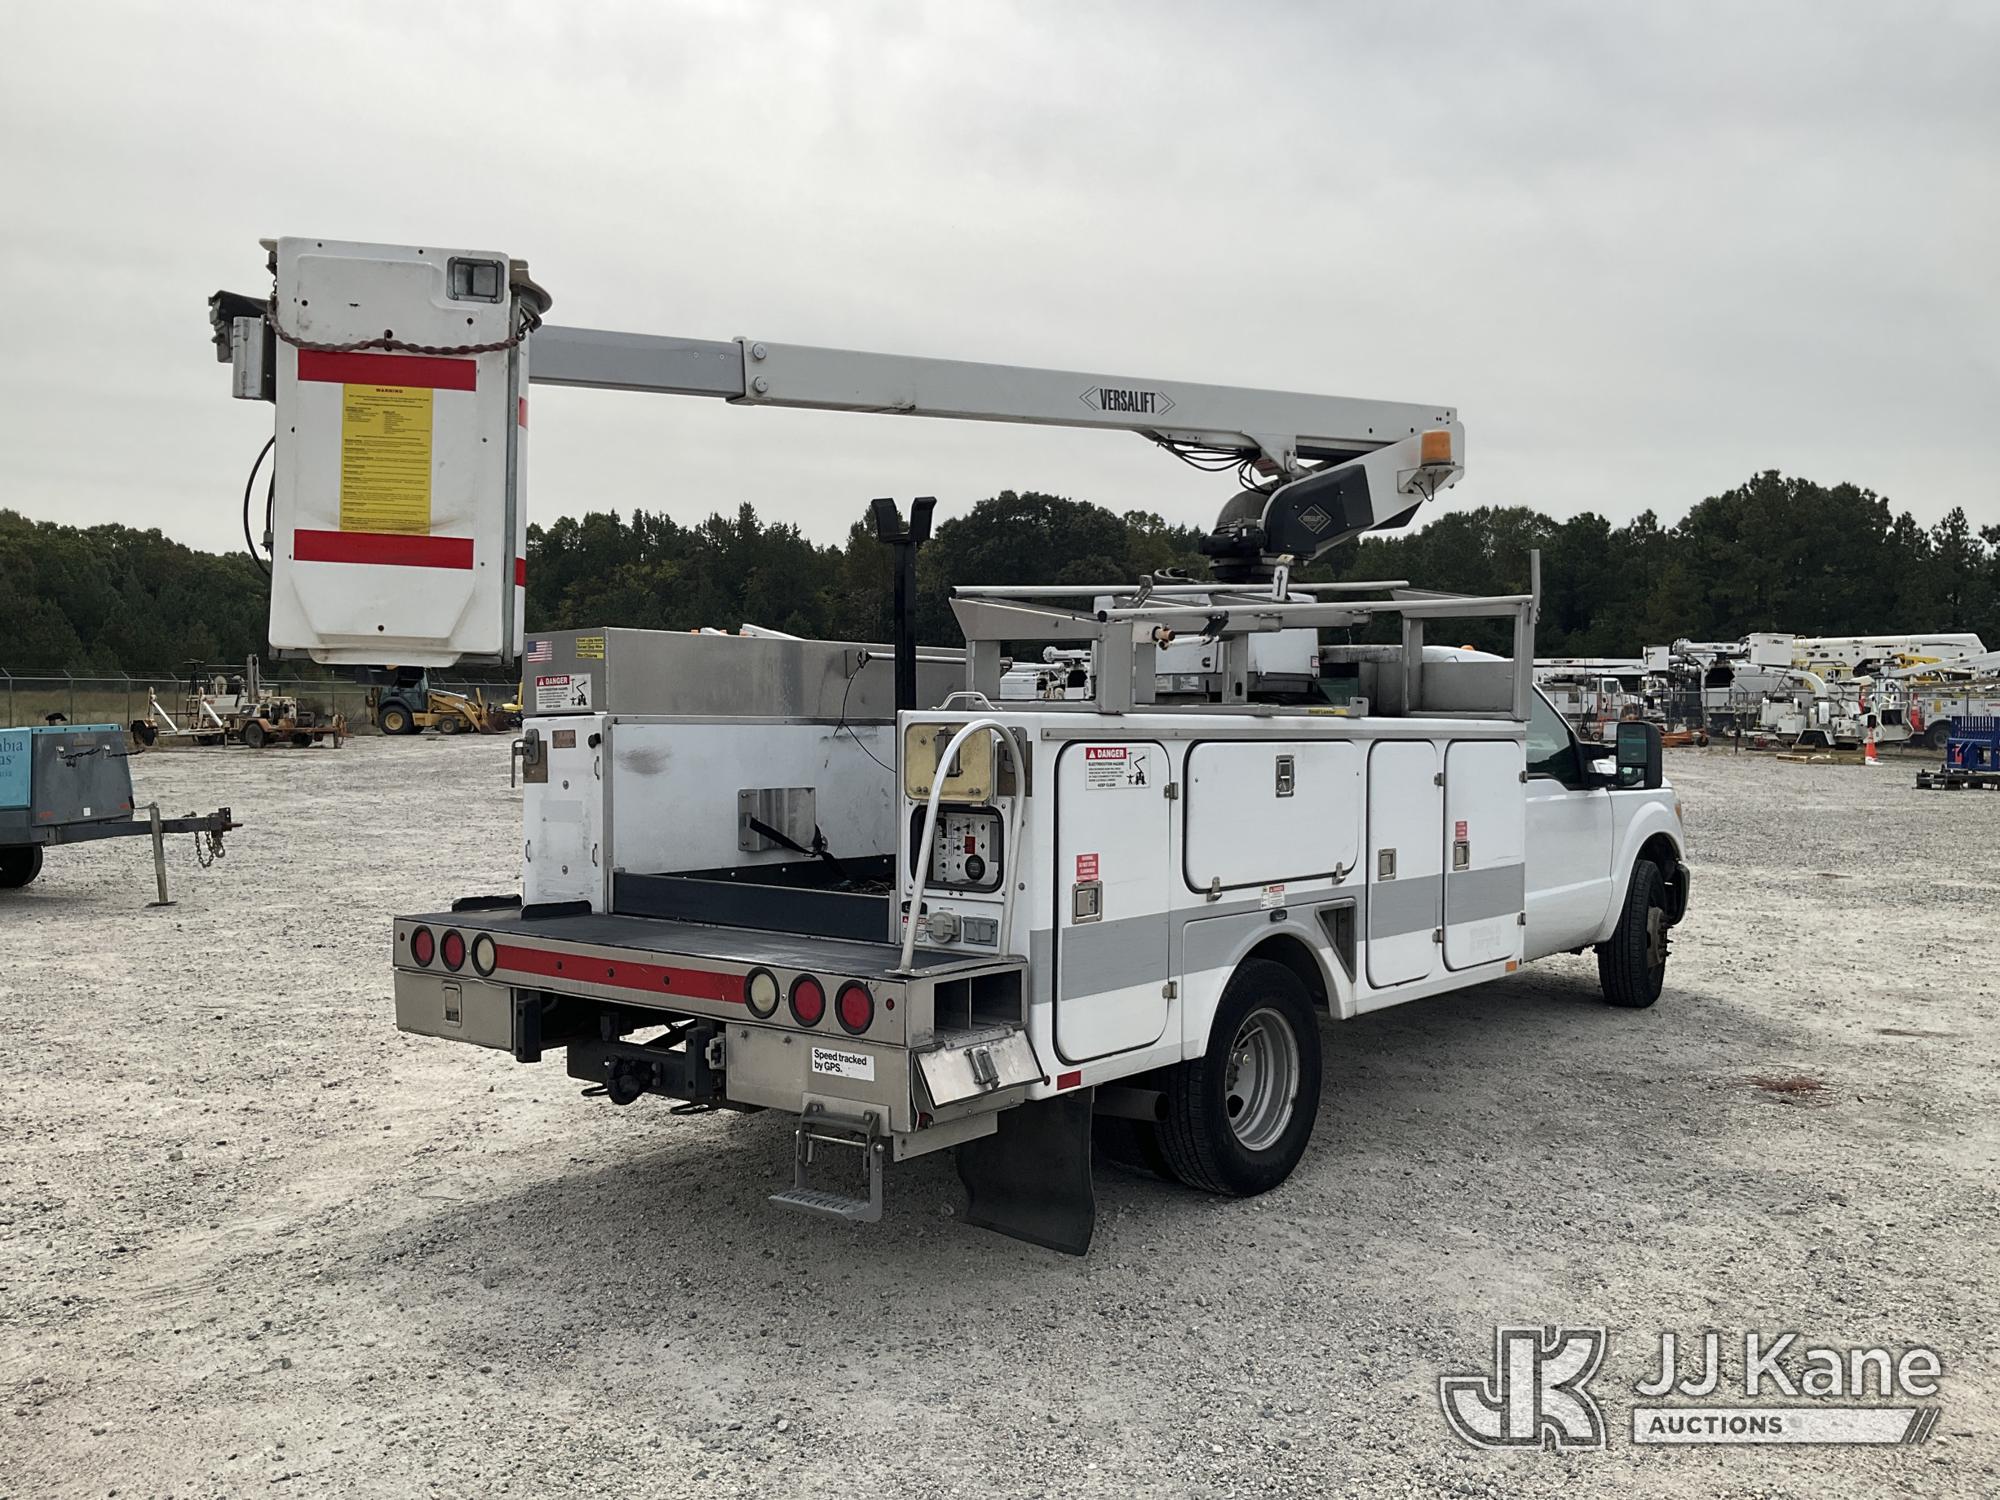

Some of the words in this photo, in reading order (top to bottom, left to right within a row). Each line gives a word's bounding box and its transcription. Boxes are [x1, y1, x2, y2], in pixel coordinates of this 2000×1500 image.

[1100, 388, 1156, 413] VERSALIFT
[545, 676, 568, 685] DANGER
[1097, 749, 1124, 758] DANGER
[814, 1049, 838, 1061] Speed
[839, 1053, 867, 1066] tracked
[814, 1060, 823, 1071] by
[824, 1061, 843, 1073] GPS.
